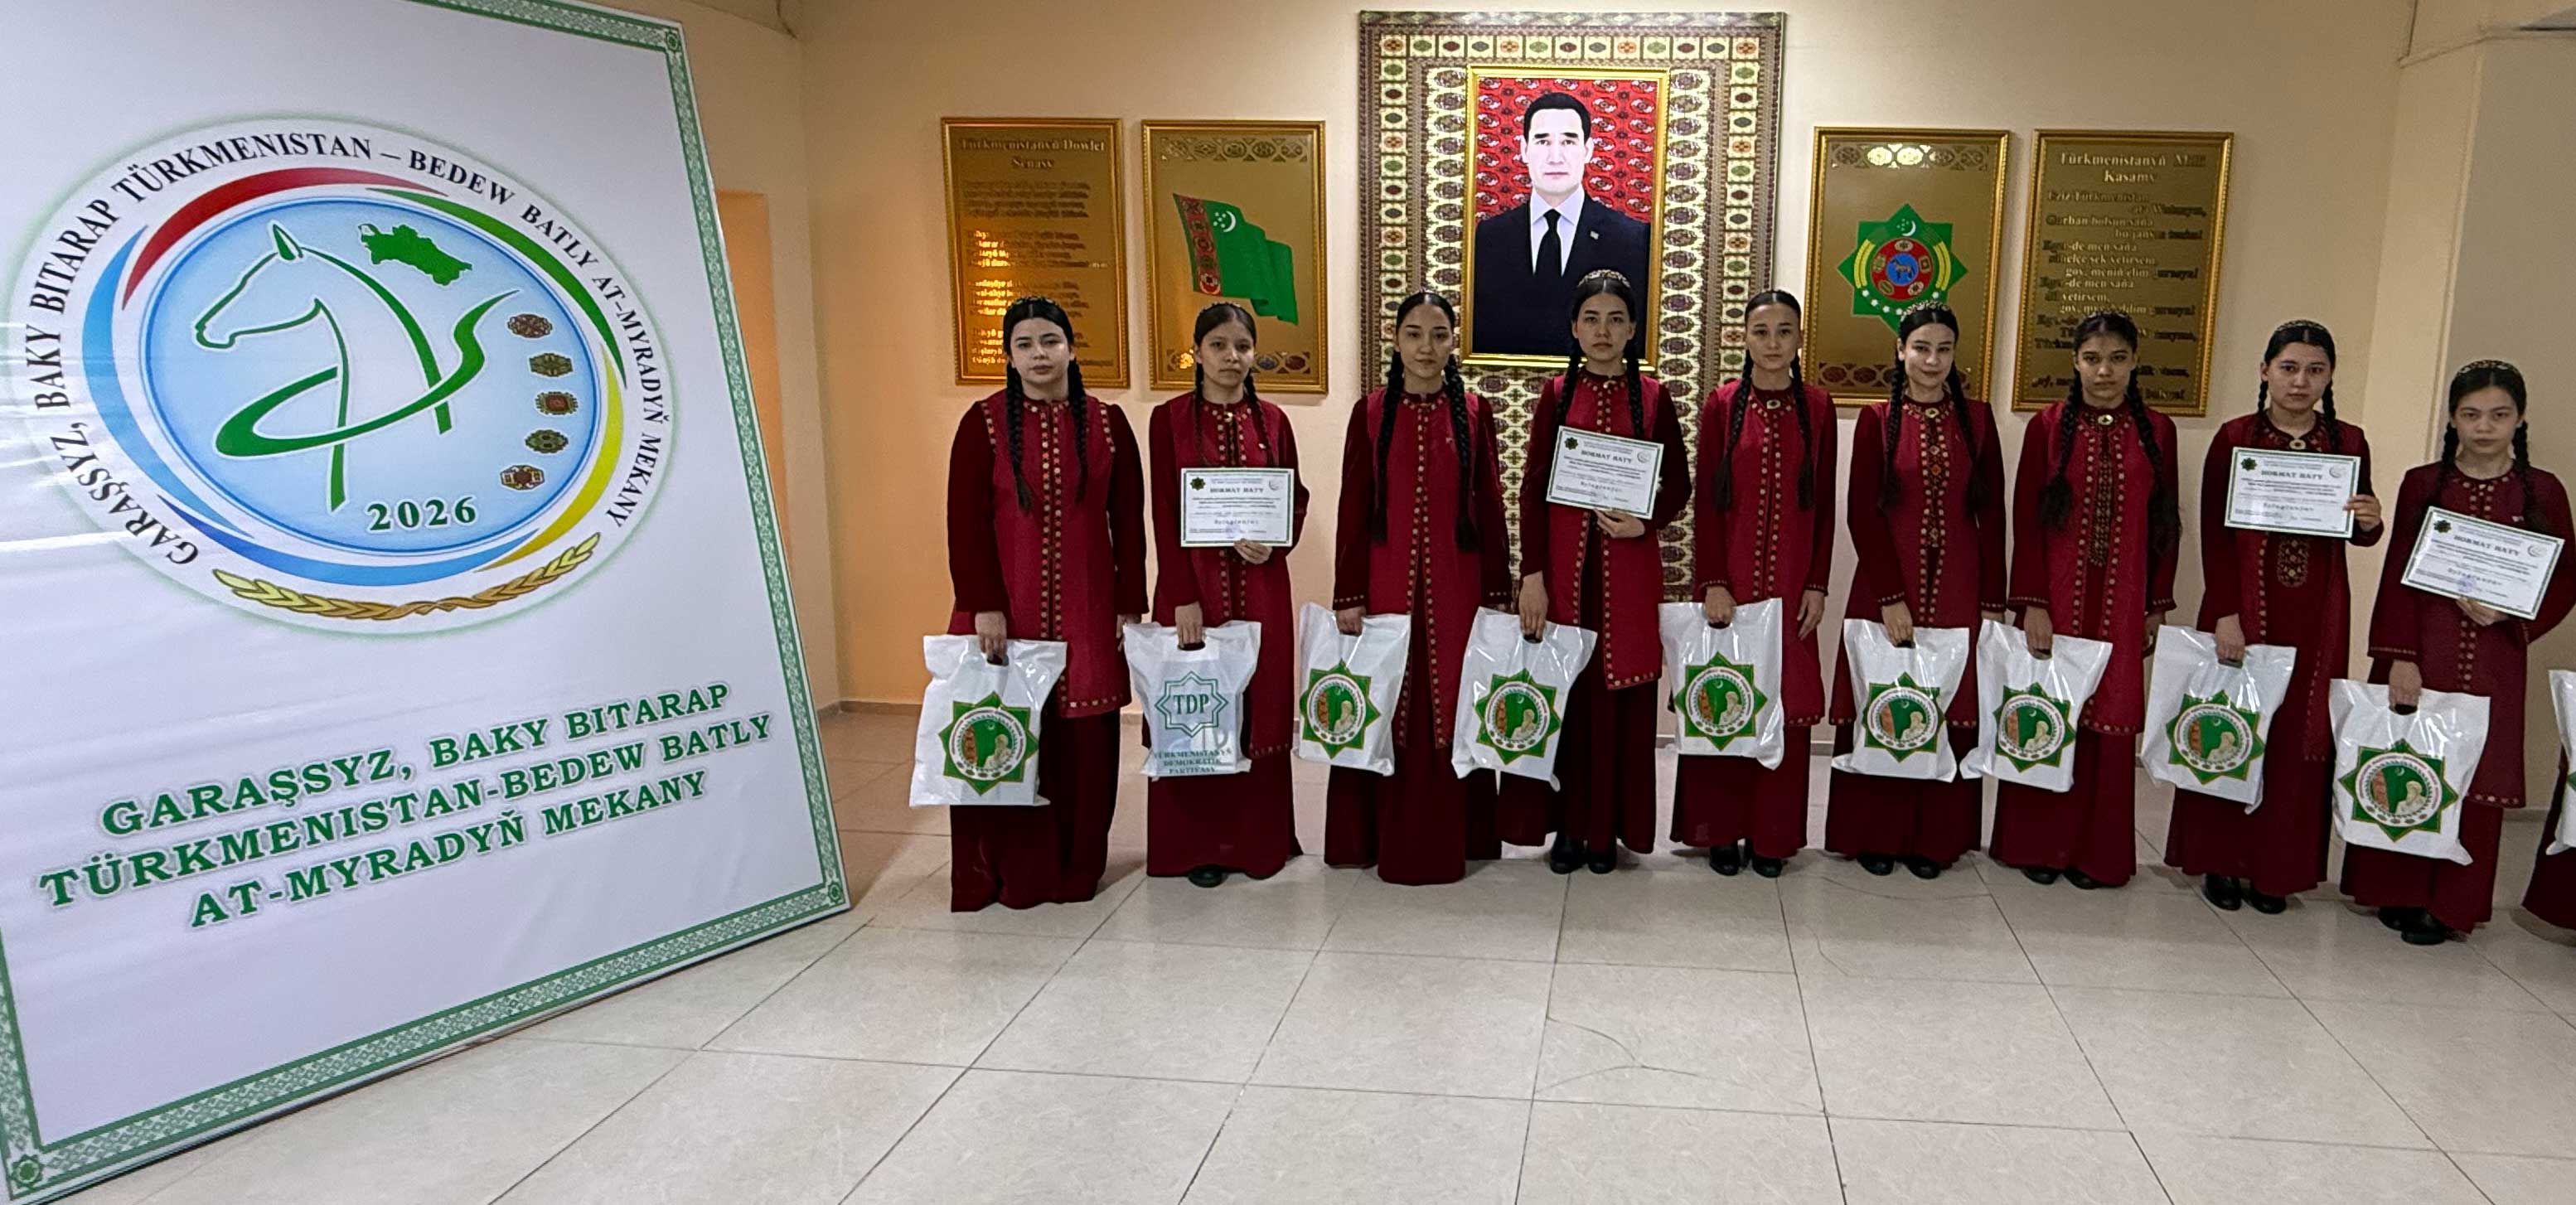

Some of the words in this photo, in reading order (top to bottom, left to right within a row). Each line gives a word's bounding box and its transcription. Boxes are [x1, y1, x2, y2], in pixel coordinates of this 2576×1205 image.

[111, 132, 372, 203] TÜRKMENISTAN
[408, 149, 516, 206] BEDEW
[29, 199, 119, 314] BITARAP
[520, 205, 599, 269] BATLY
[26, 320, 70, 409] BAKY
[591, 275, 669, 423] AT-MYRADYŇ
[51, 421, 199, 565] GARAŞSYZ,
[367, 496, 477, 533] 2026
[605, 432, 662, 530] MEKANY
[1174, 694, 1210, 715] TDP
[102, 748, 413, 836] GARAŞSYZ,
[431, 718, 550, 770] BAKY
[566, 683, 731, 738] BITARAP
[40, 742, 646, 907] TÜRKMENISTAN-BEDEW
[661, 714, 772, 763] BATLY
[191, 808, 525, 928] AT-MYRADYŇ
[544, 771, 706, 837] MEKANY
